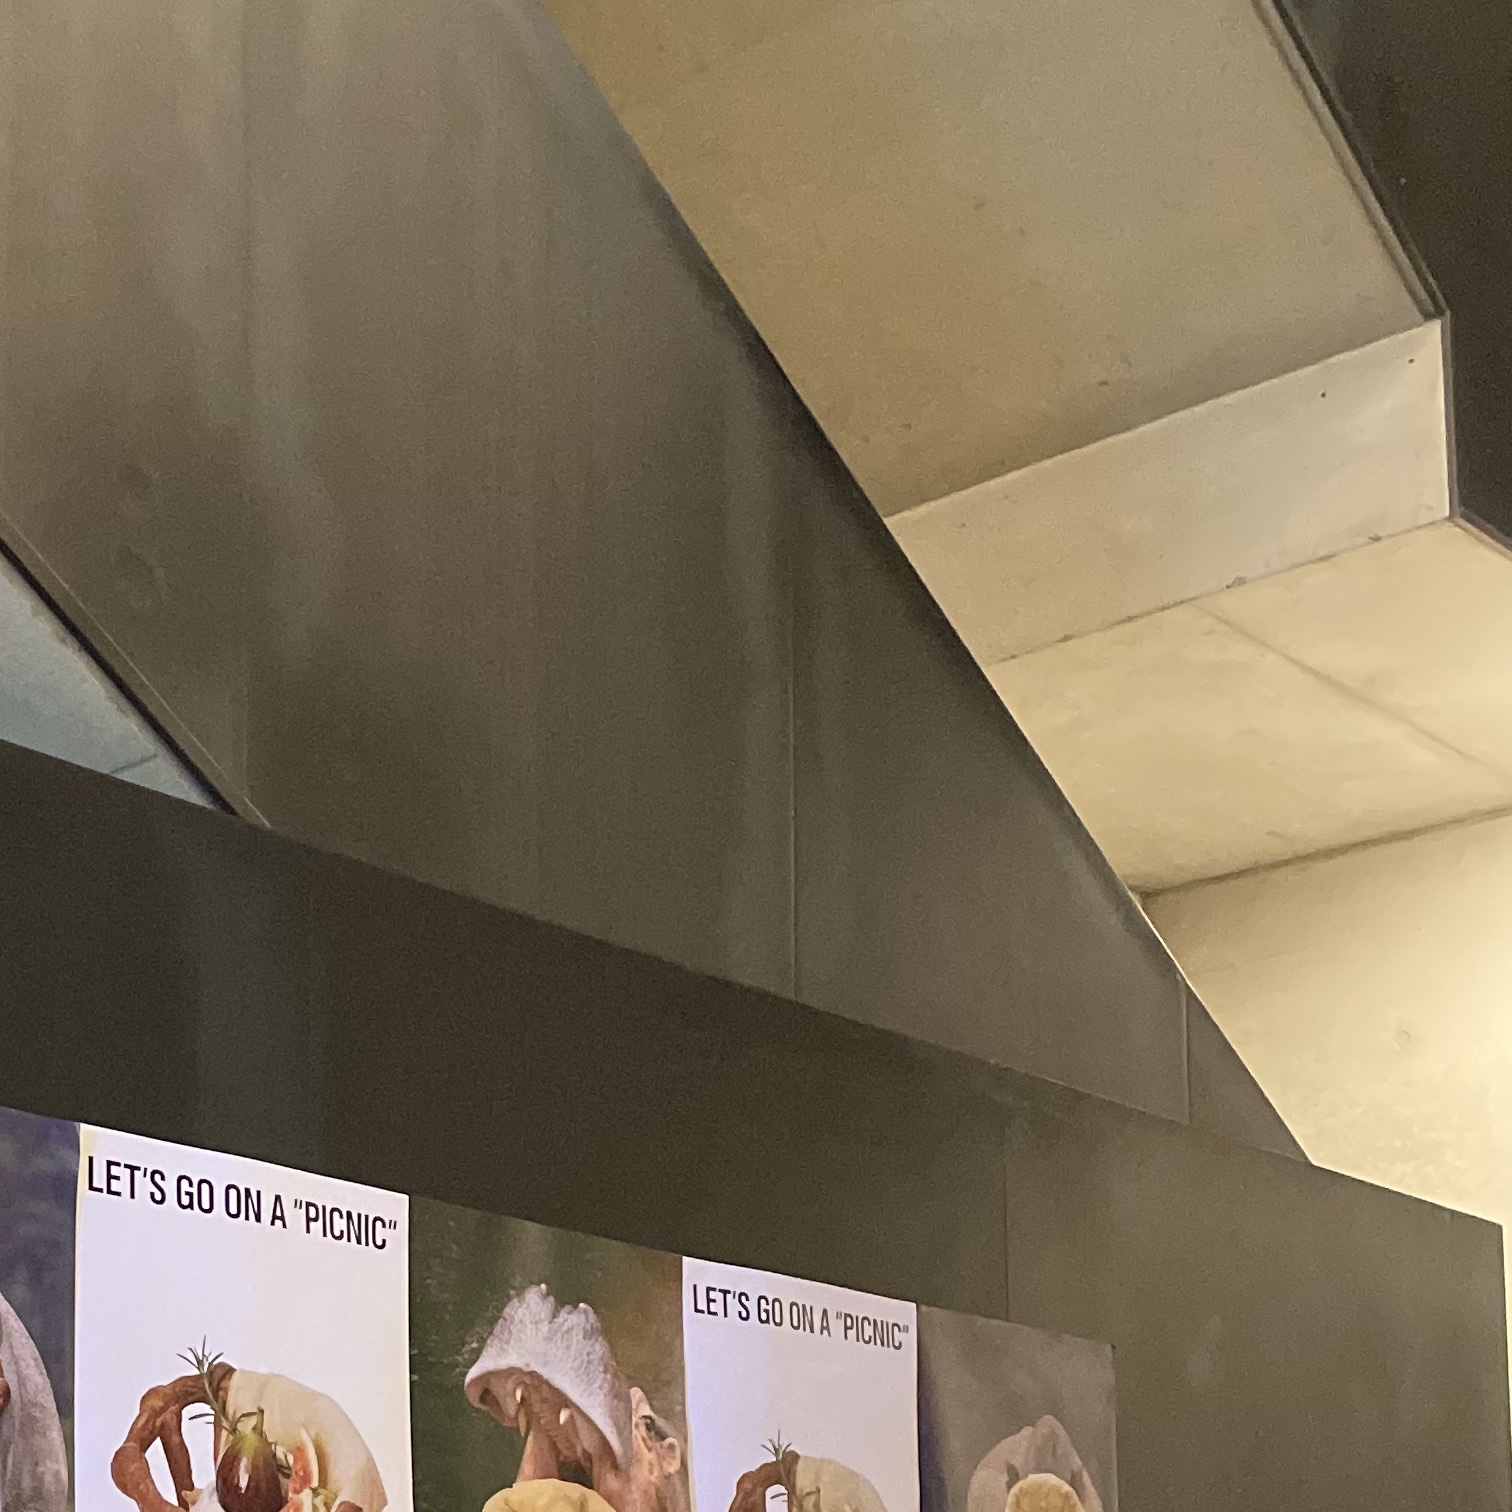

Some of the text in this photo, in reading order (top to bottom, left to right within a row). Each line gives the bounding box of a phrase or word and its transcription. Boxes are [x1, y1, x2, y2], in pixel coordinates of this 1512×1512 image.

[87, 1155, 397, 1250] LET'S GO ON A "PICNIC"
[692, 1283, 909, 1350] LET'S GO ON A "PICNIC"
